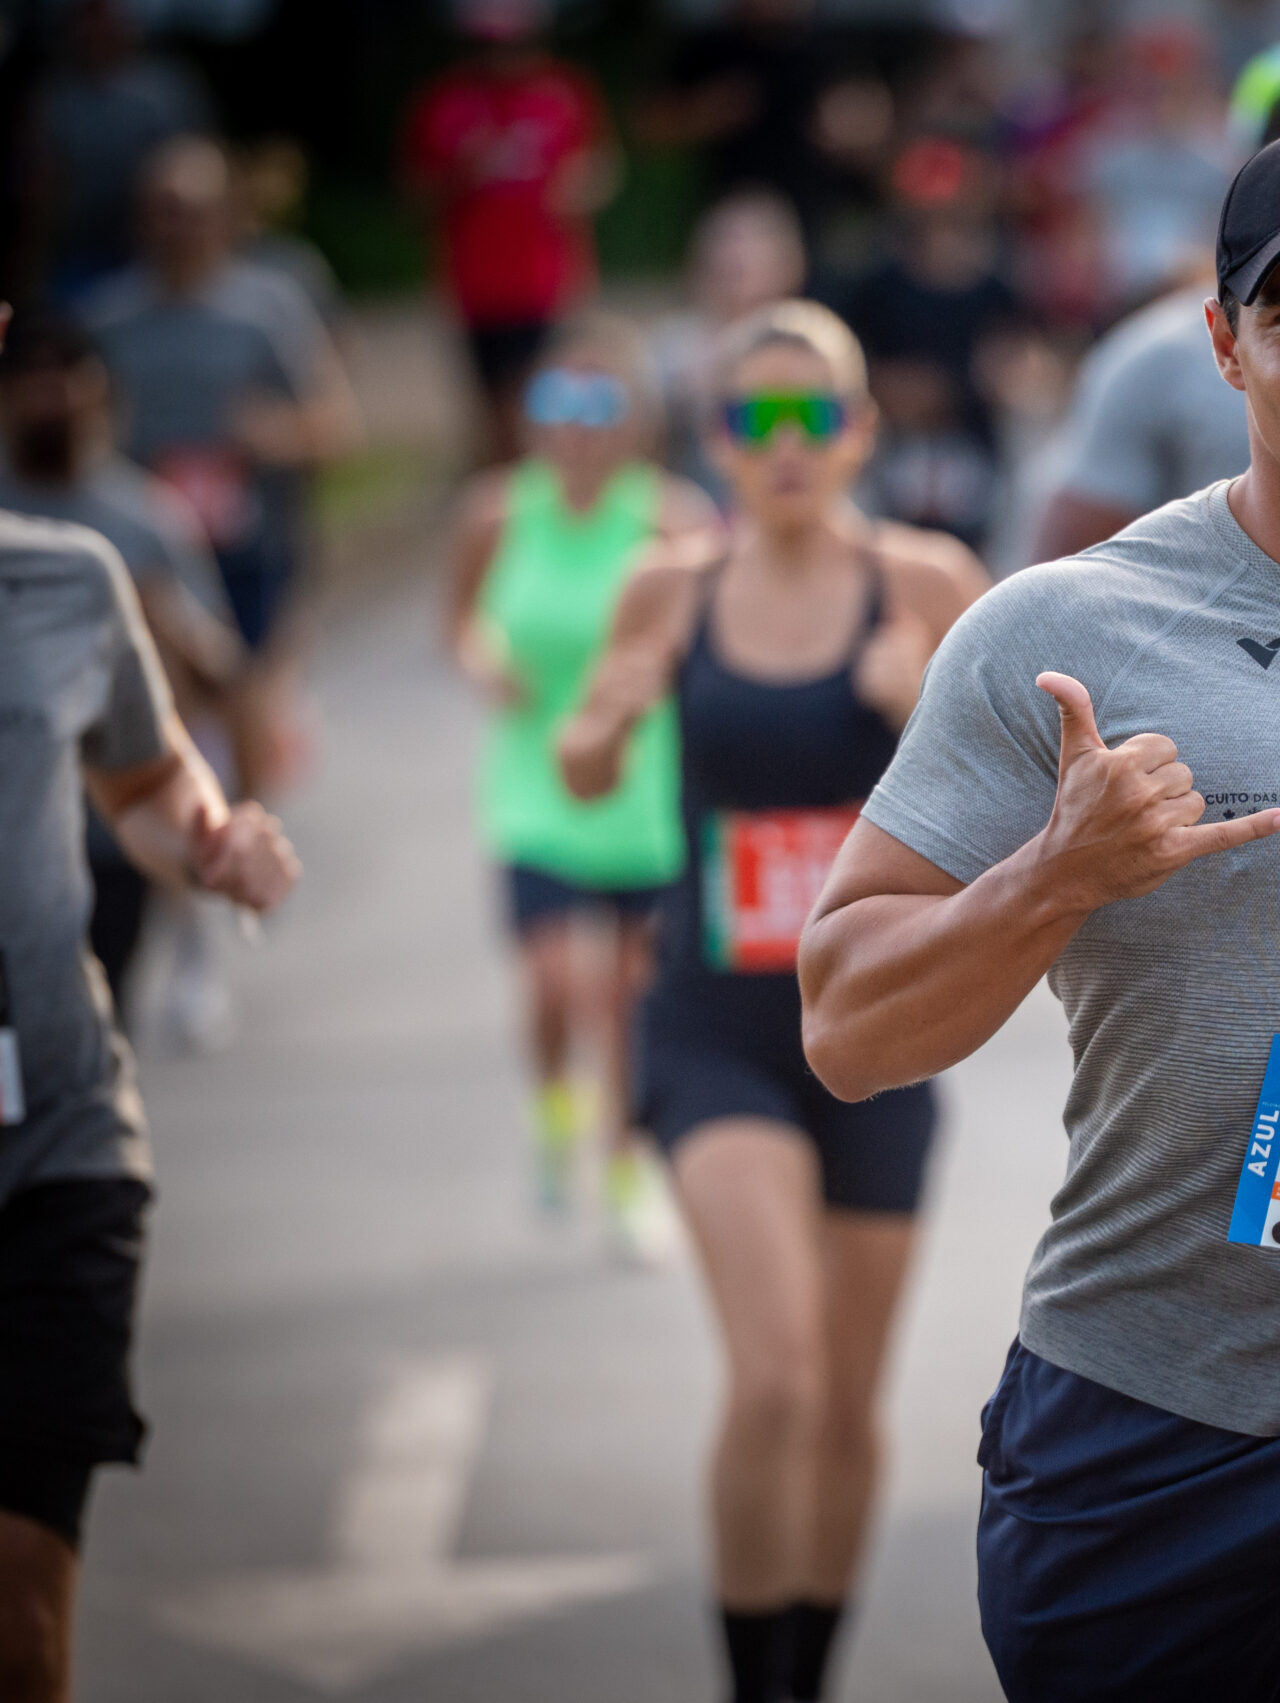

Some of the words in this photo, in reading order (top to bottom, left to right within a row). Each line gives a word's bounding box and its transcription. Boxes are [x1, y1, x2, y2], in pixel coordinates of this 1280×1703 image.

[1205, 792, 1249, 805] CUITO
[1253, 793, 1278, 803] DAS
[1247, 1110, 1280, 1177] AZUL
